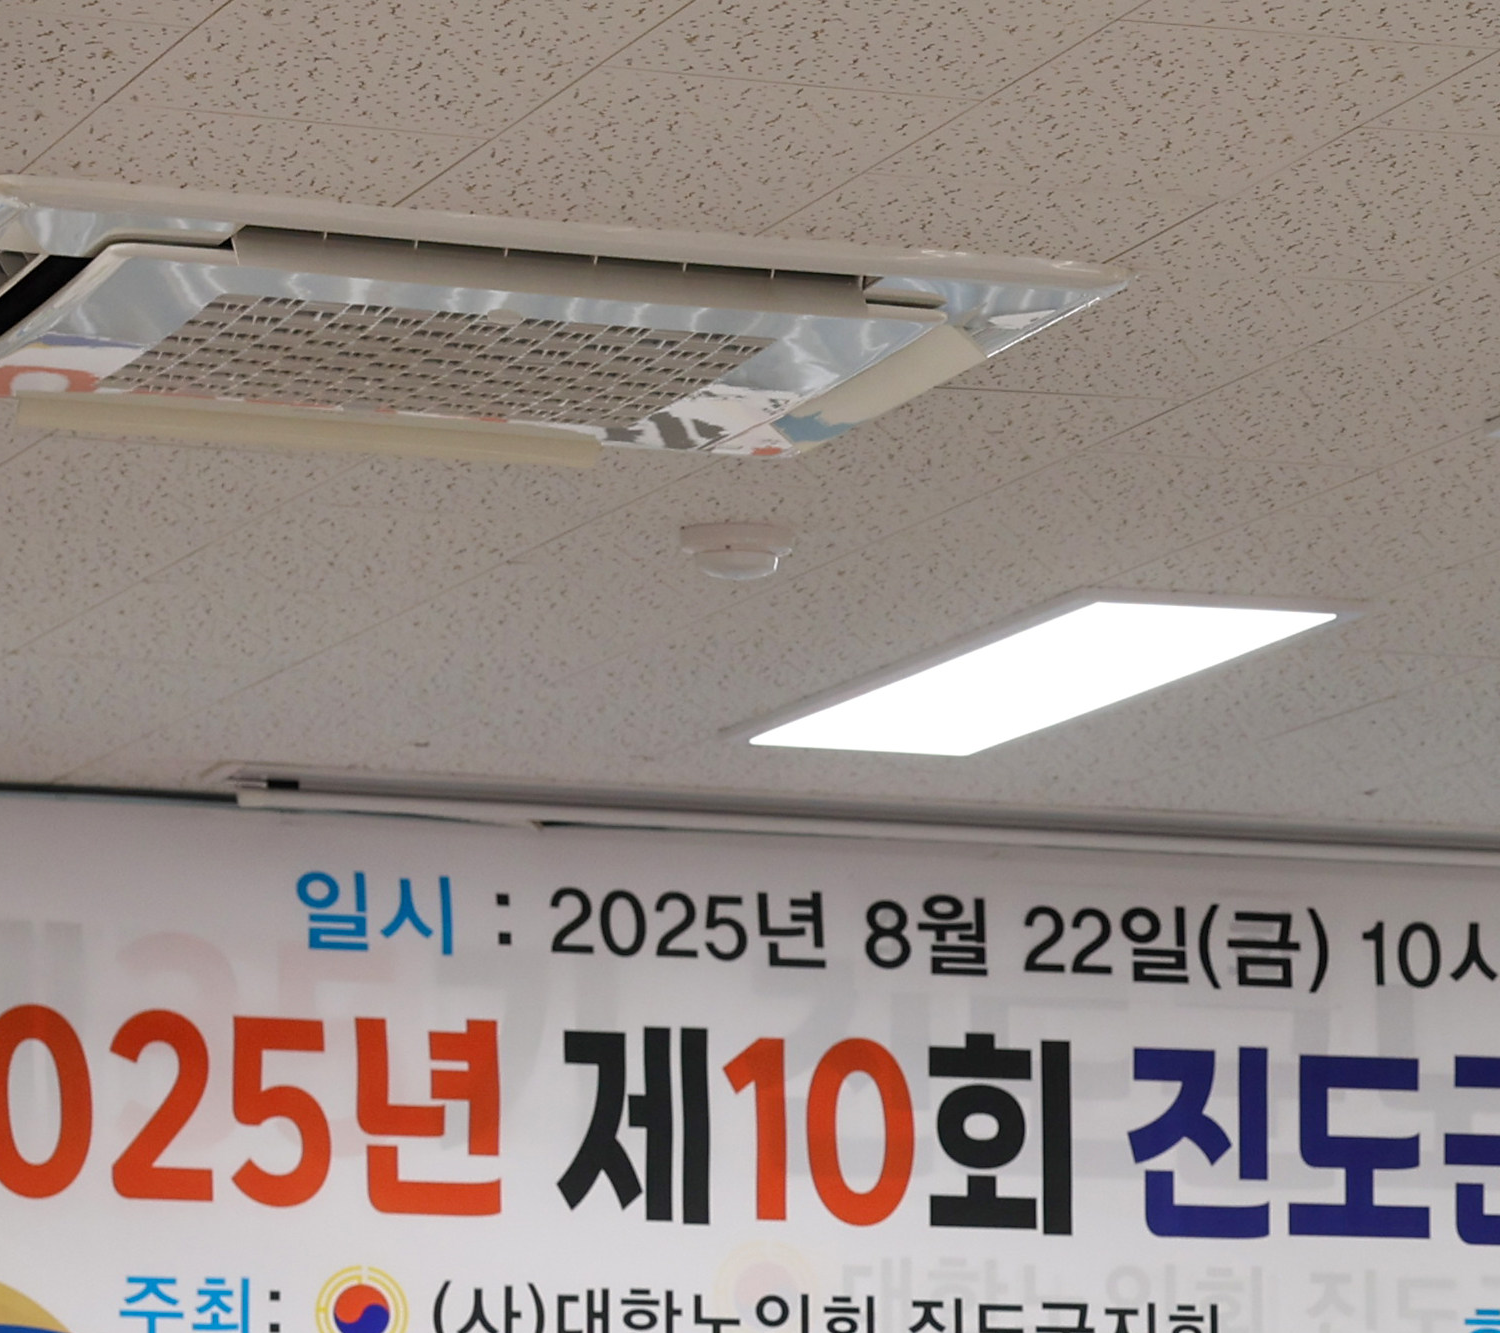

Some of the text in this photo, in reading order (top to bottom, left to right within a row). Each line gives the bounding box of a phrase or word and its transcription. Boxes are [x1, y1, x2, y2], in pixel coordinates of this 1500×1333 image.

[297, 872, 452, 955] 일시
[551, 888, 826, 968] 2025년
[866, 895, 987, 976] 8월
[1025, 904, 1328, 992] 22일(금)
[557, 1027, 1072, 1235] 제10회
